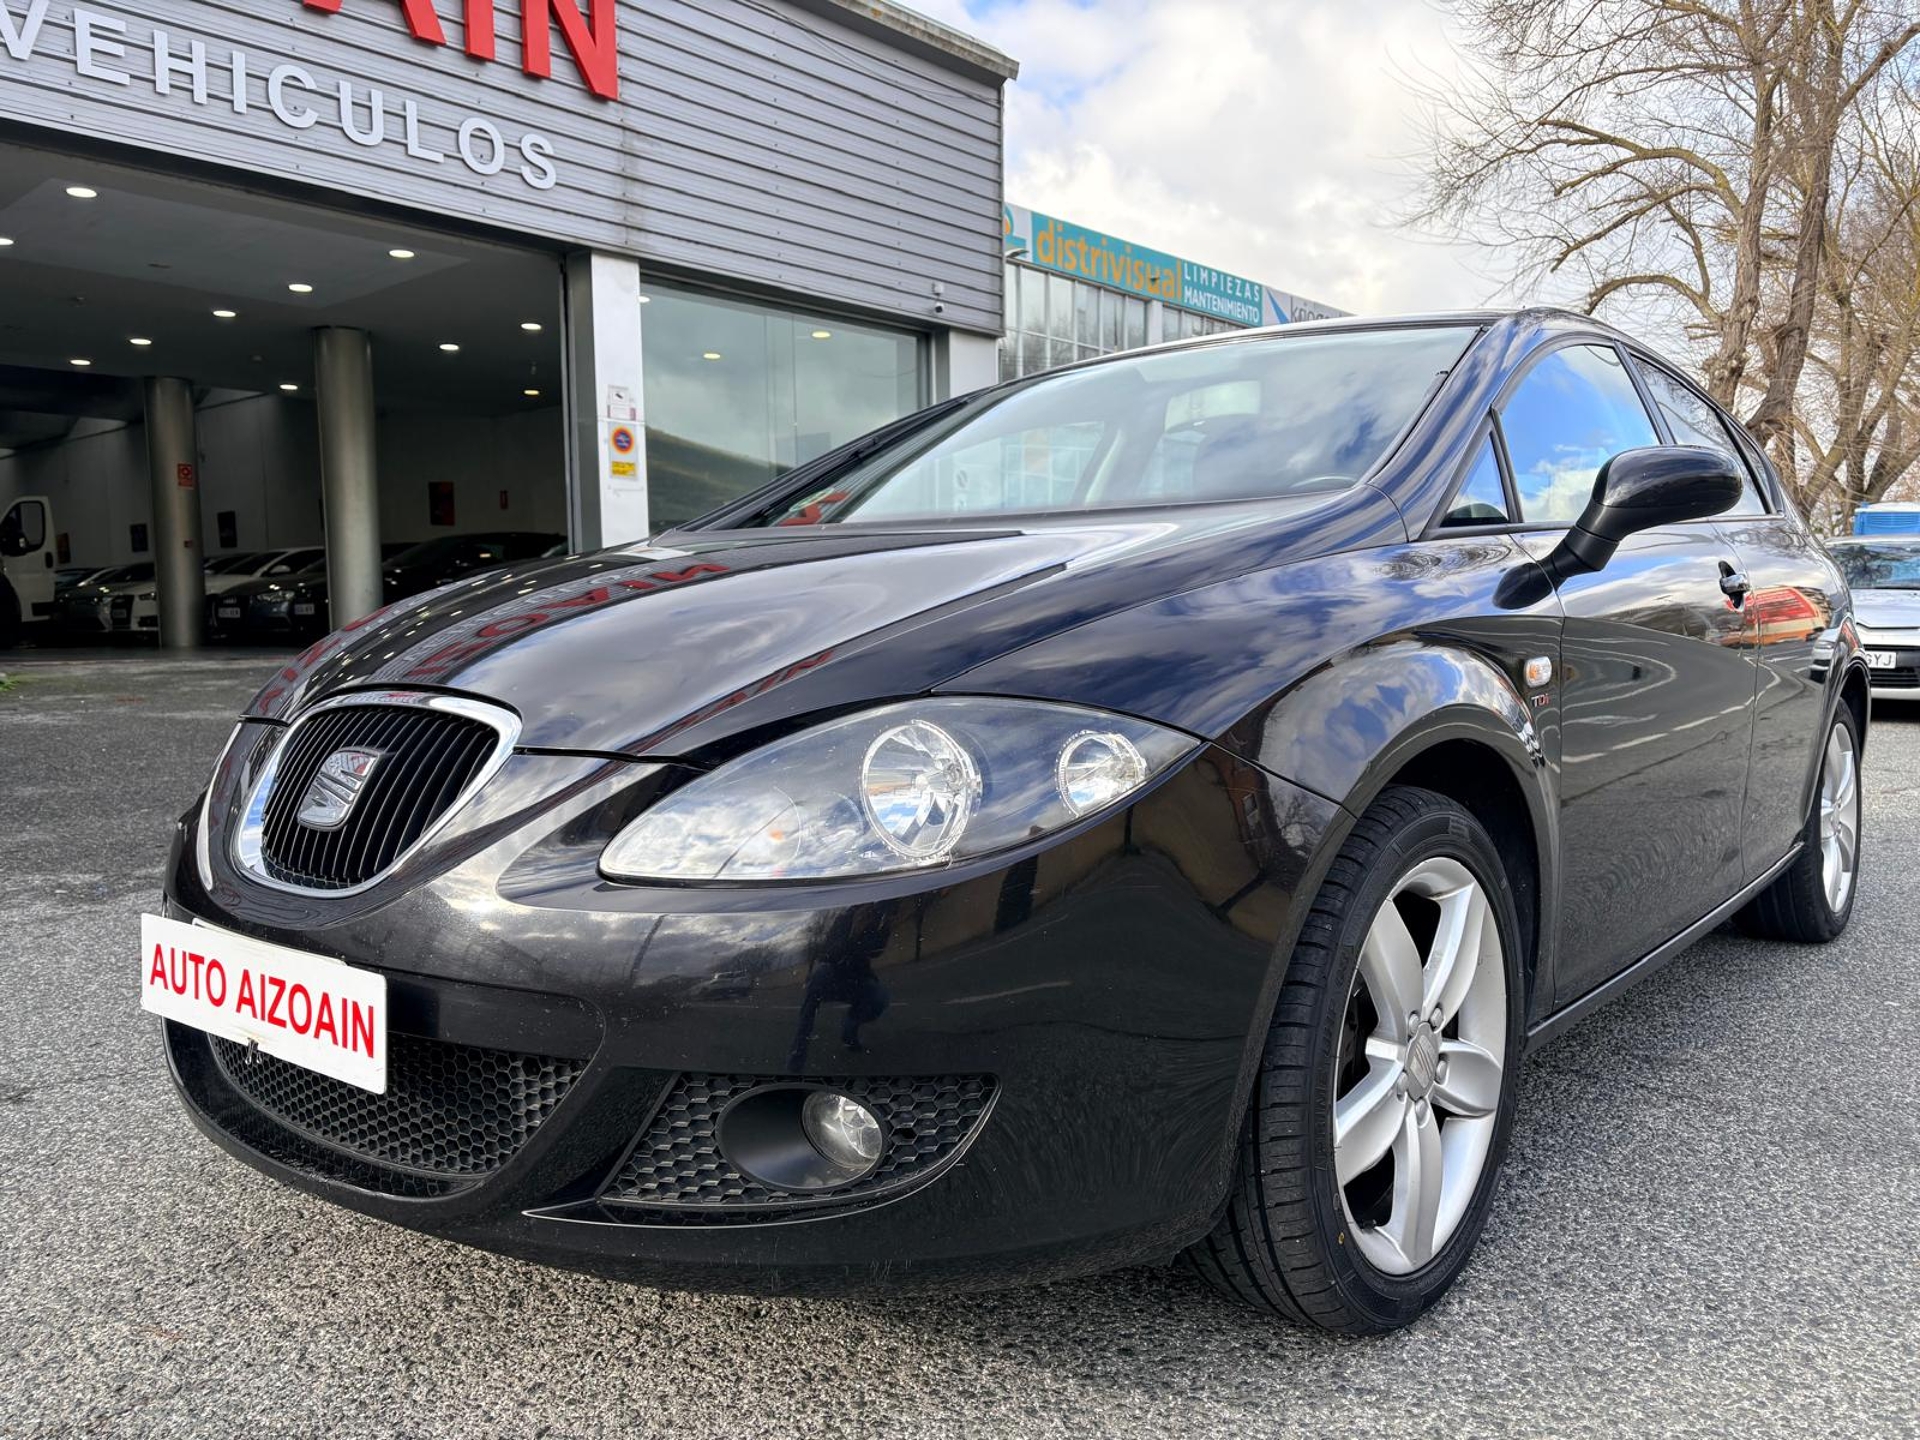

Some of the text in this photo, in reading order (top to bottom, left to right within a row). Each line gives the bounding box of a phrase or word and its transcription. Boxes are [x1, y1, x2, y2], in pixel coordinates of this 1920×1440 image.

[0, 0, 557, 190] VEHICULOS
[1037, 218, 1182, 299] distrivisual
[1184, 262, 1260, 302] LIMPIEZAS
[1184, 285, 1260, 323] MANTENIMIENTO
[150, 943, 374, 1059] AUTO AIZOAIN
